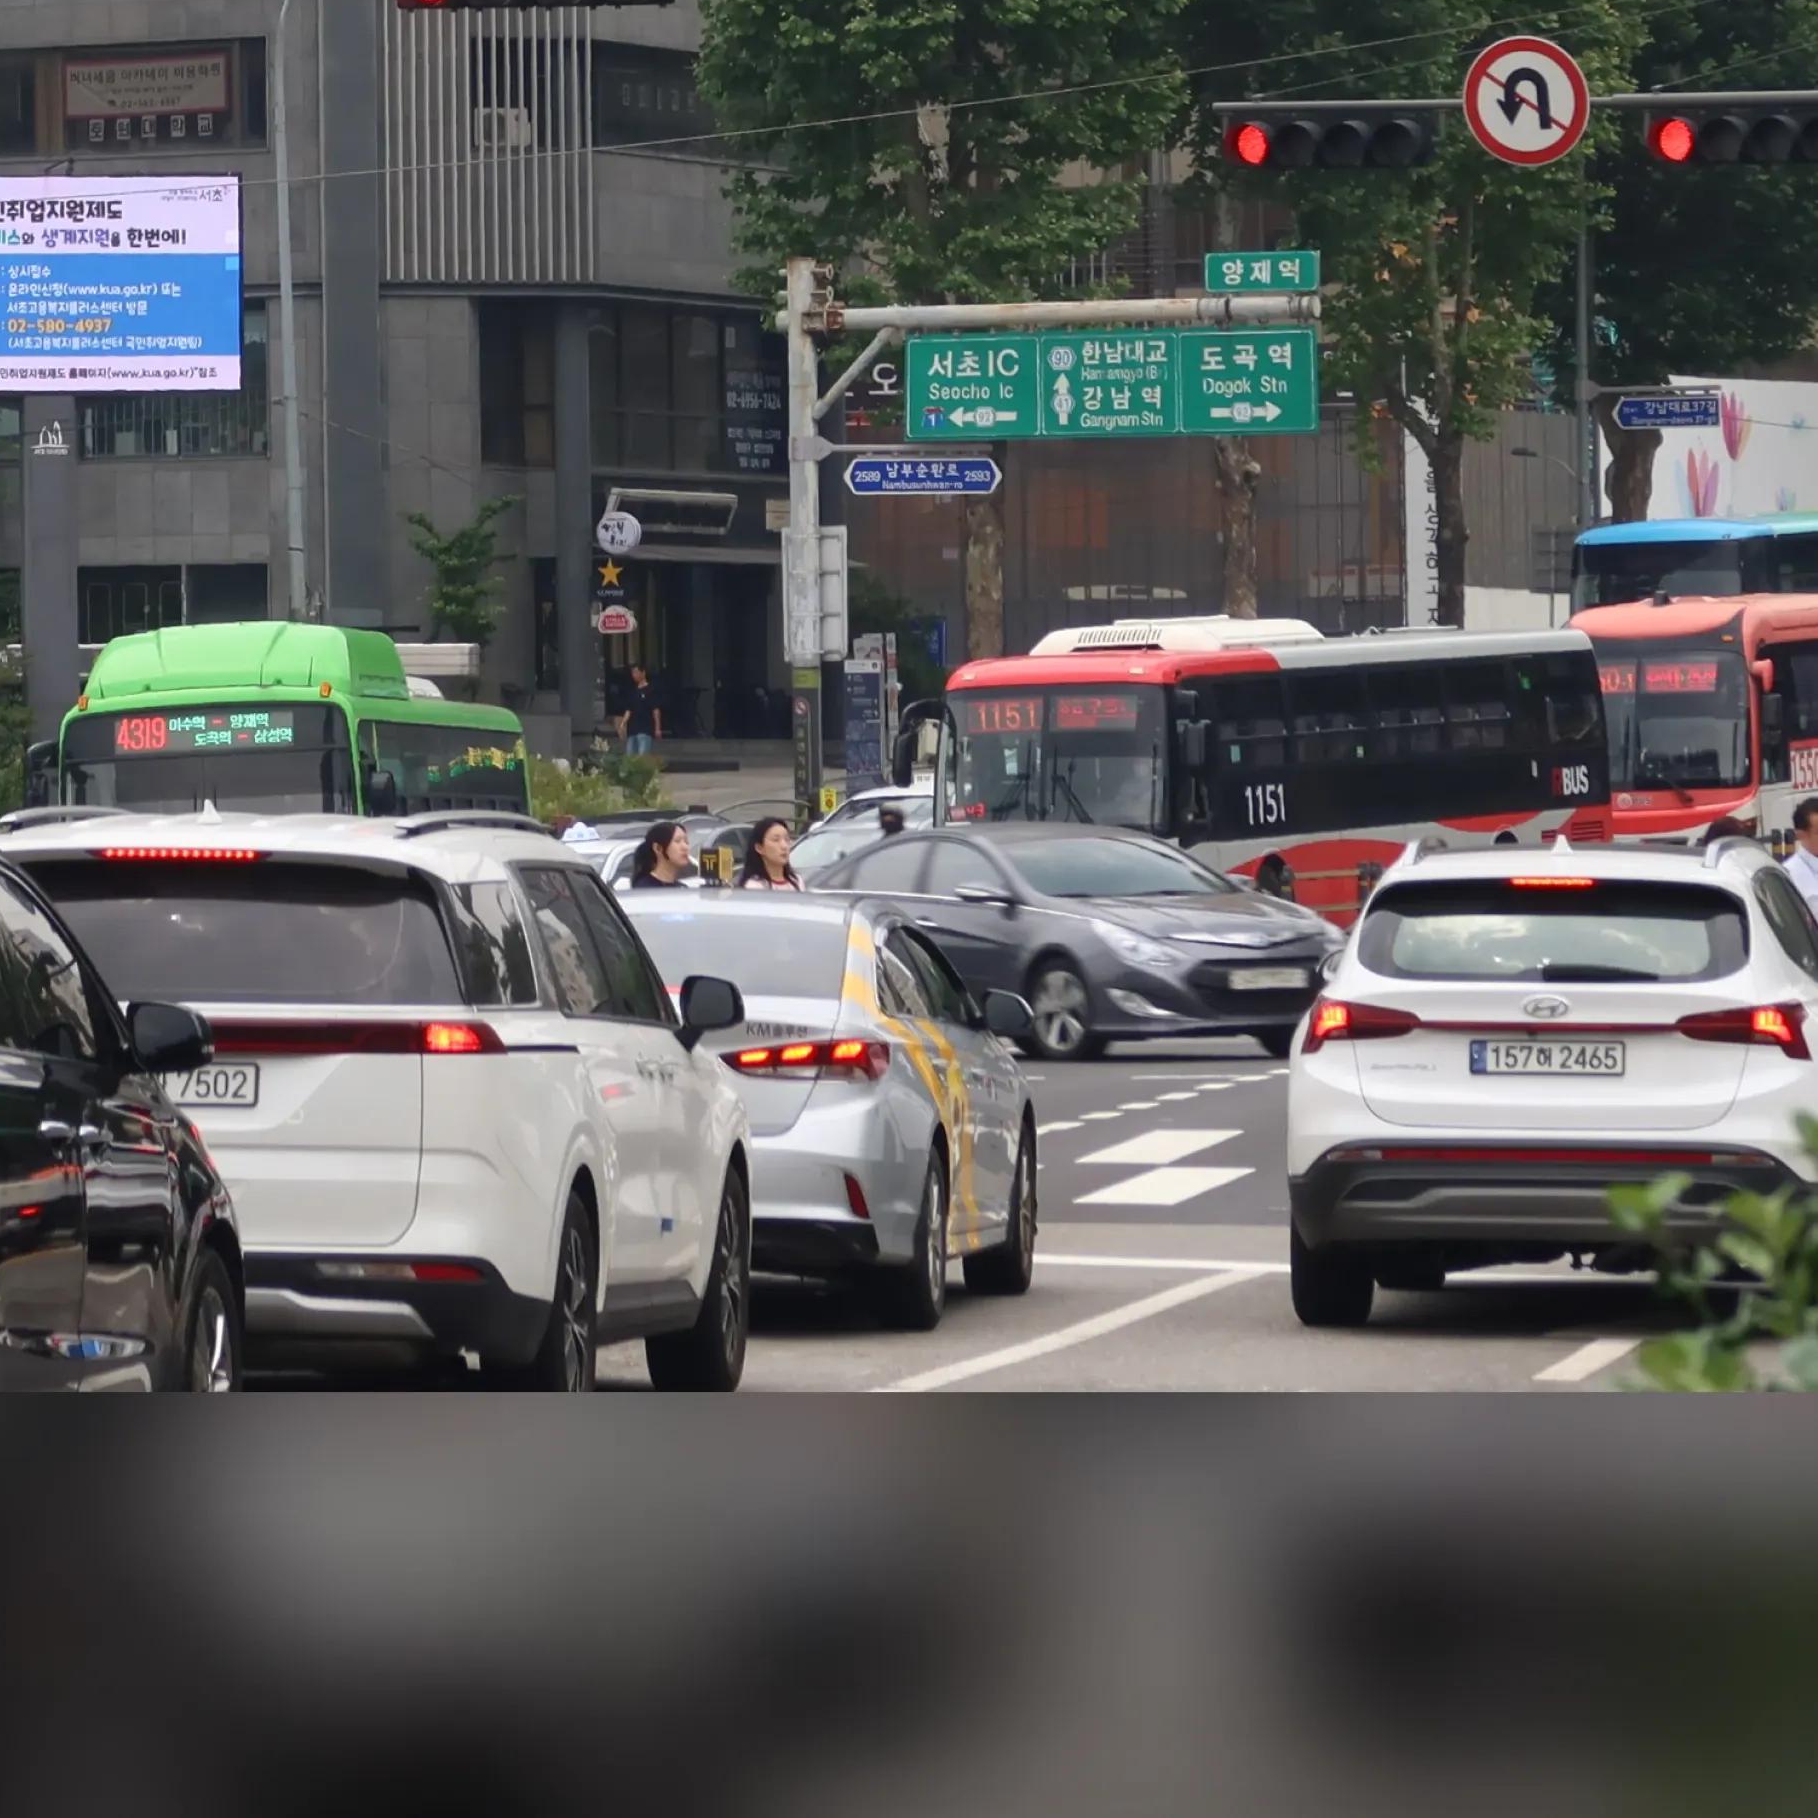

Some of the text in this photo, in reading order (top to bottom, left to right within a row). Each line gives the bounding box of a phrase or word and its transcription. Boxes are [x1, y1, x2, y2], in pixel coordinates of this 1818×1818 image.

[199, 188, 224, 202] 서초
[41, 227, 121, 248] 생계지원을
[126, 227, 187, 248] 한번에!
[8, 265, 52, 280] 상시접수
[1221, 258, 1301, 285] 양재역
[7, 318, 113, 334] 02-580-4937
[927, 348, 1020, 379] 서초IC
[1082, 339, 1168, 365] 한남대교
[1200, 341, 1292, 372] 도곡역
[928, 382, 991, 400] Seocho
[1082, 385, 1162, 411] 강남역
[1202, 375, 1288, 399] Dogok Stn
[1080, 410, 1164, 431] Gangnam Stn
[853, 470, 882, 483] 2589
[885, 461, 961, 479] 남부순환로
[168, 712, 270, 732] 이수역 양재역
[977, 702, 1036, 731] 1151
[116, 716, 167, 751] 4319
[1245, 782, 1286, 826] 1151
[1490, 1045, 1618, 1070] 157허 2465
